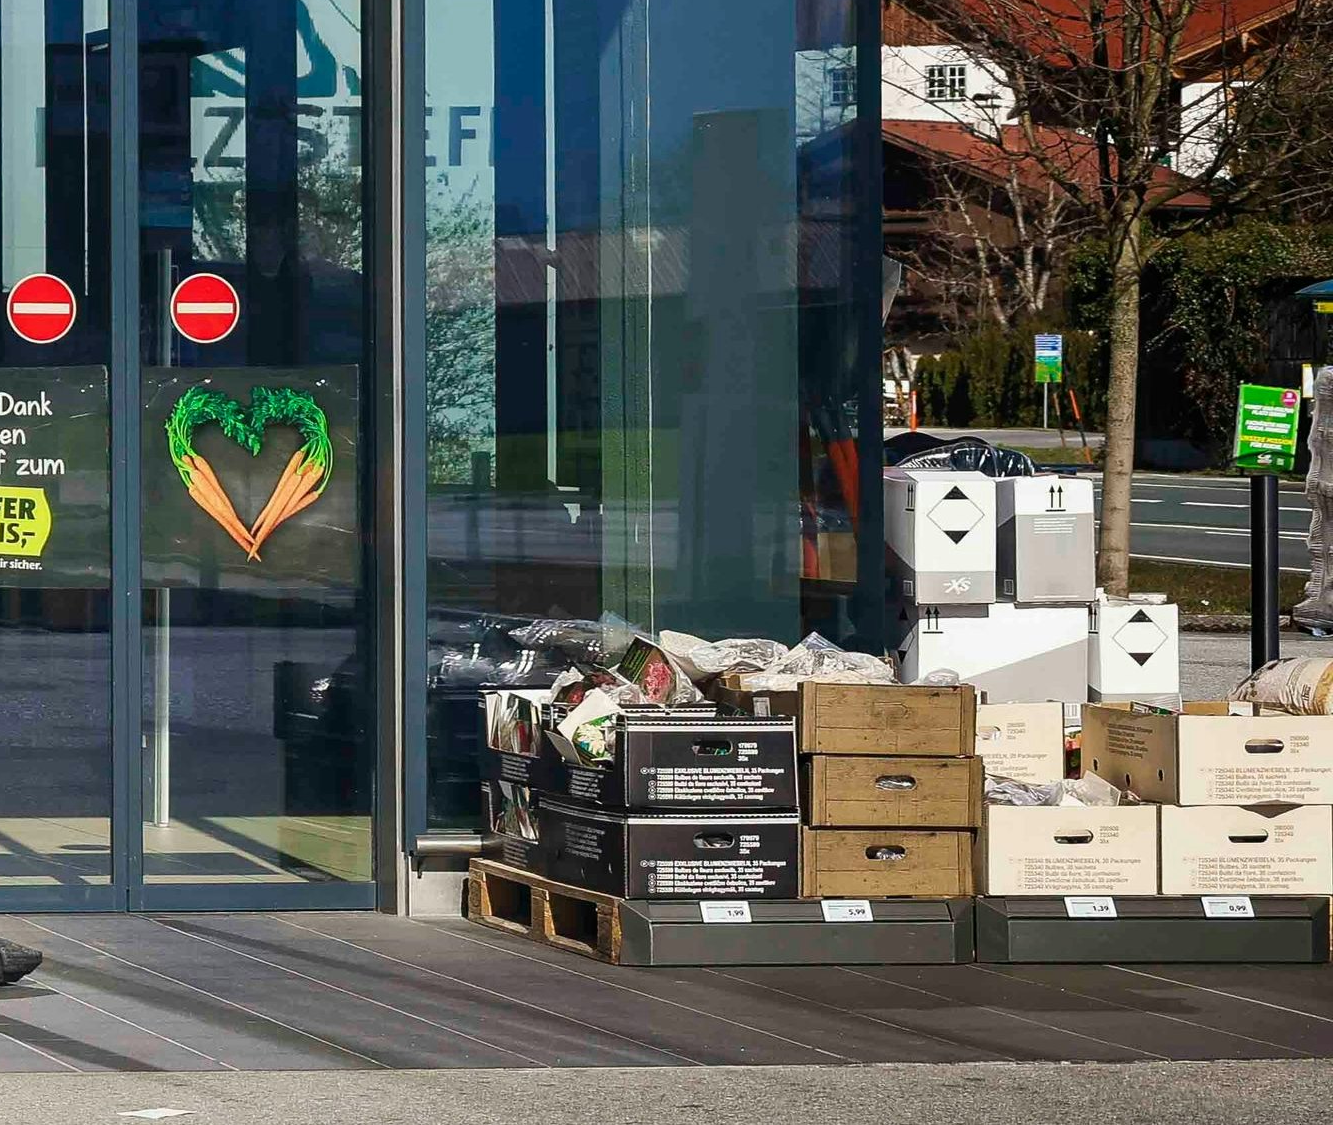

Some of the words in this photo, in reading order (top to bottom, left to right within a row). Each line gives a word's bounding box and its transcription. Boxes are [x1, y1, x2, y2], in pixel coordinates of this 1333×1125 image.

[16, 456, 66, 476] zum
[9, 557, 44, 571] sicher.
[849, 908, 866, 916] 5,99
[1092, 904, 1109, 912] 1,39
[727, 909, 744, 917] 1,99
